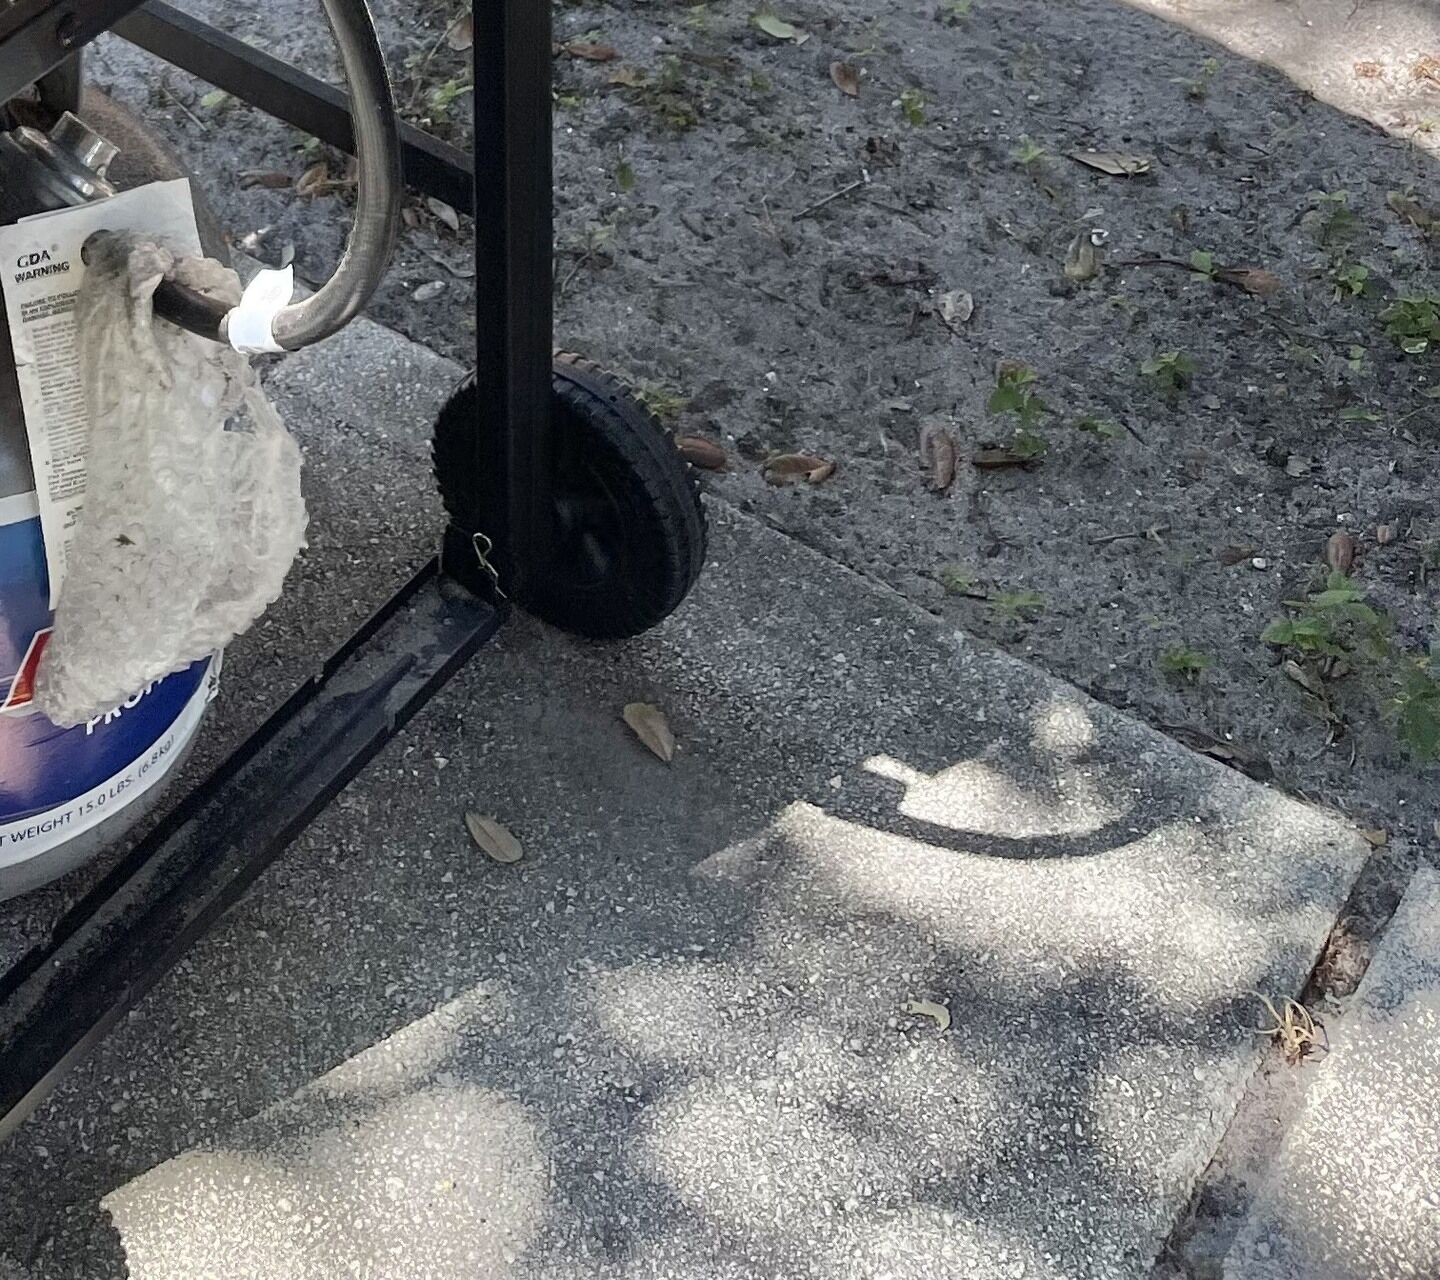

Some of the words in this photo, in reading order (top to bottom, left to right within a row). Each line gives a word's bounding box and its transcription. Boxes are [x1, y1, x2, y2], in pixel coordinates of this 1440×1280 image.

[14, 261, 70, 284] WARNING
[10, 810, 74, 843] WEIGHT
[78, 793, 107, 817] 15.0
